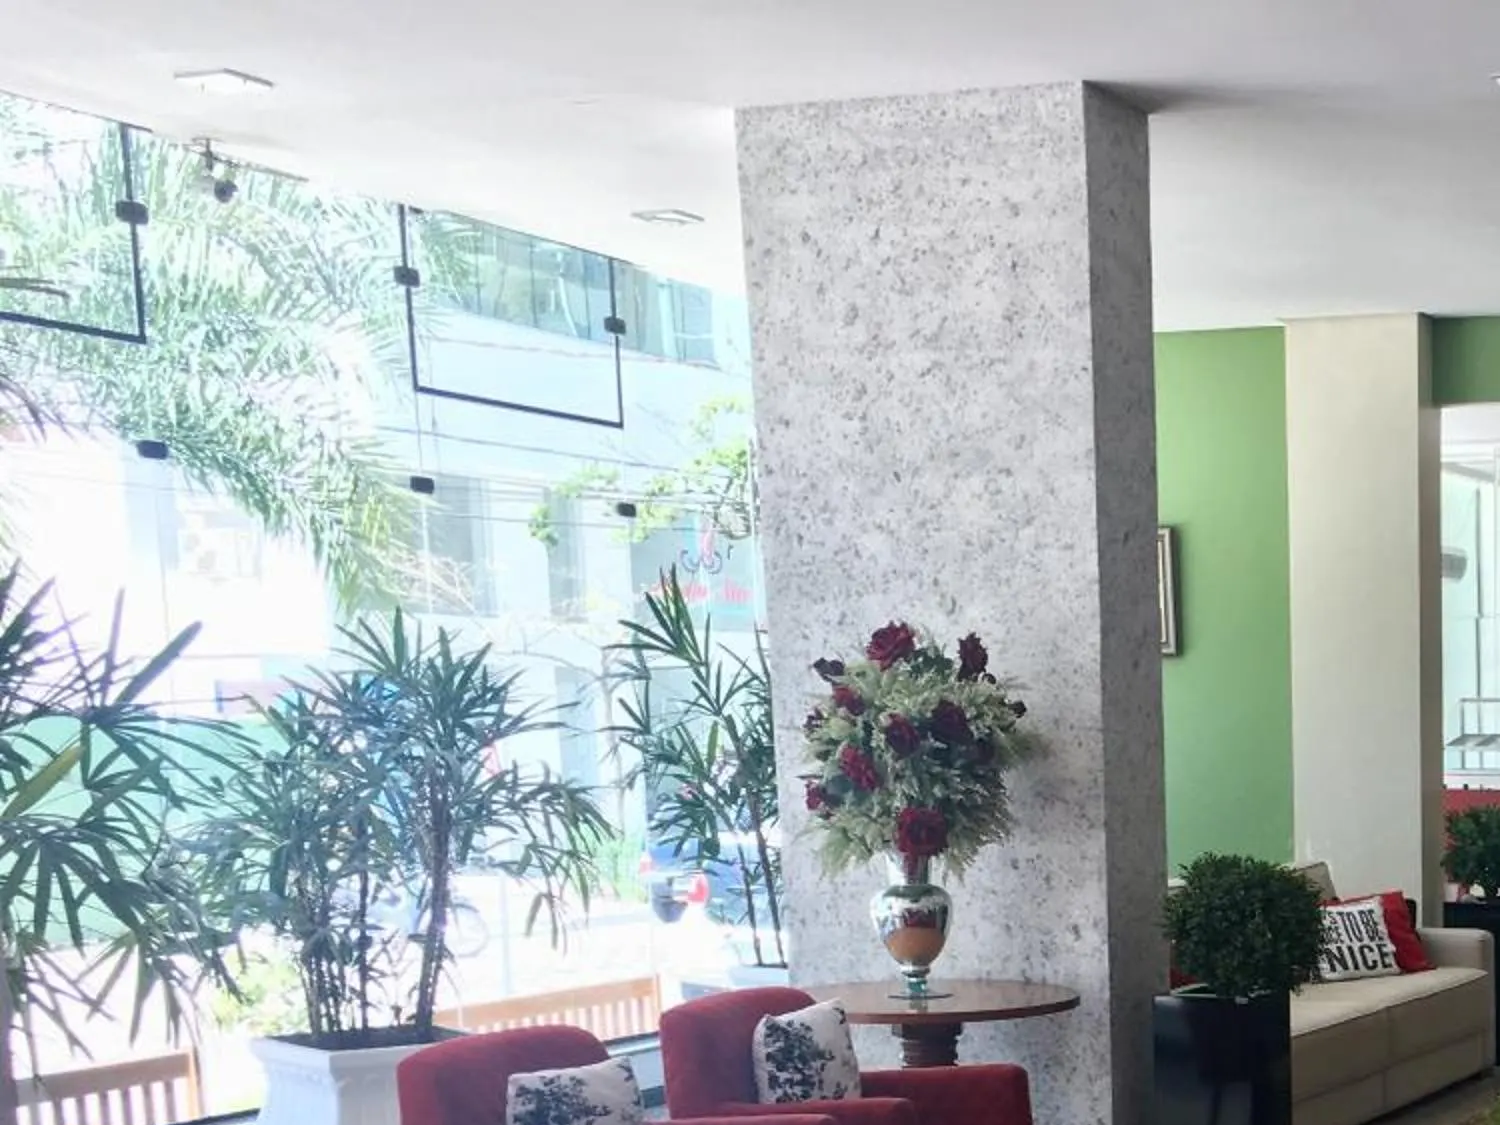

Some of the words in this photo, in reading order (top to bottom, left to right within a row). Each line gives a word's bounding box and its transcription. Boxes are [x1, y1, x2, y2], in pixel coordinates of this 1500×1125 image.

[1336, 911, 1364, 943] TO
[1357, 909, 1384, 942] BE
[1323, 943, 1393, 973] NICE
